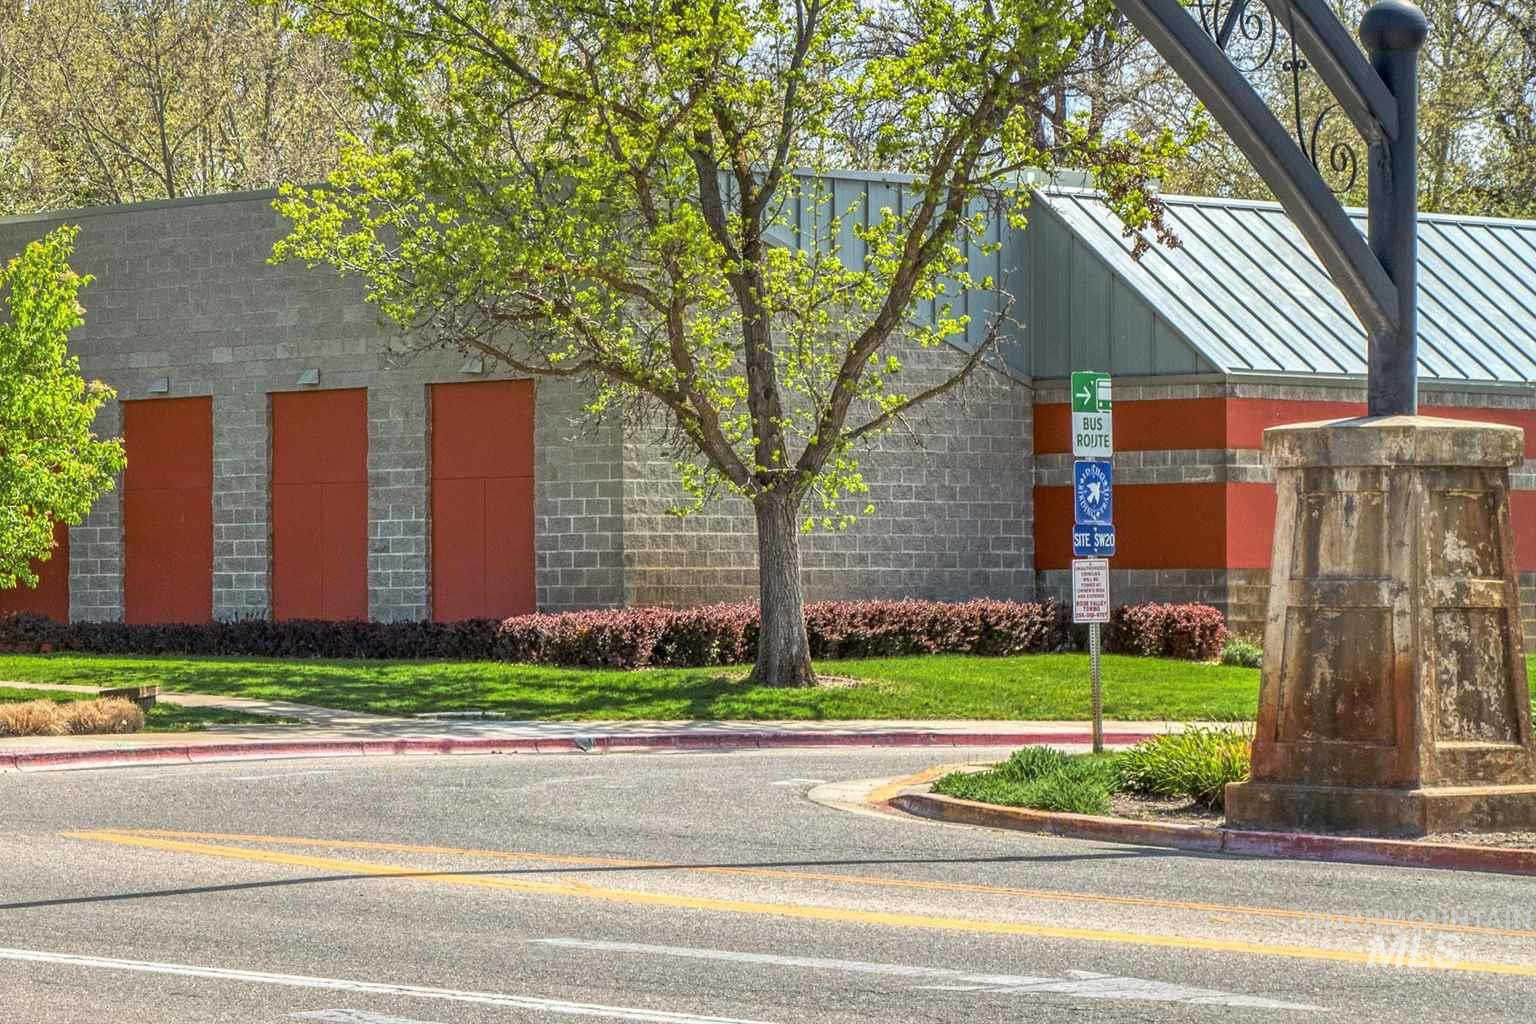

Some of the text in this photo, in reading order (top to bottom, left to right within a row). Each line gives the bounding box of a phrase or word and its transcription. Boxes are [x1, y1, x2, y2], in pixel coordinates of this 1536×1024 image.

[1083, 417, 1103, 431] BUS
[1077, 433, 1110, 448] ROUTE
[1074, 532, 1115, 547] SITE SW20
